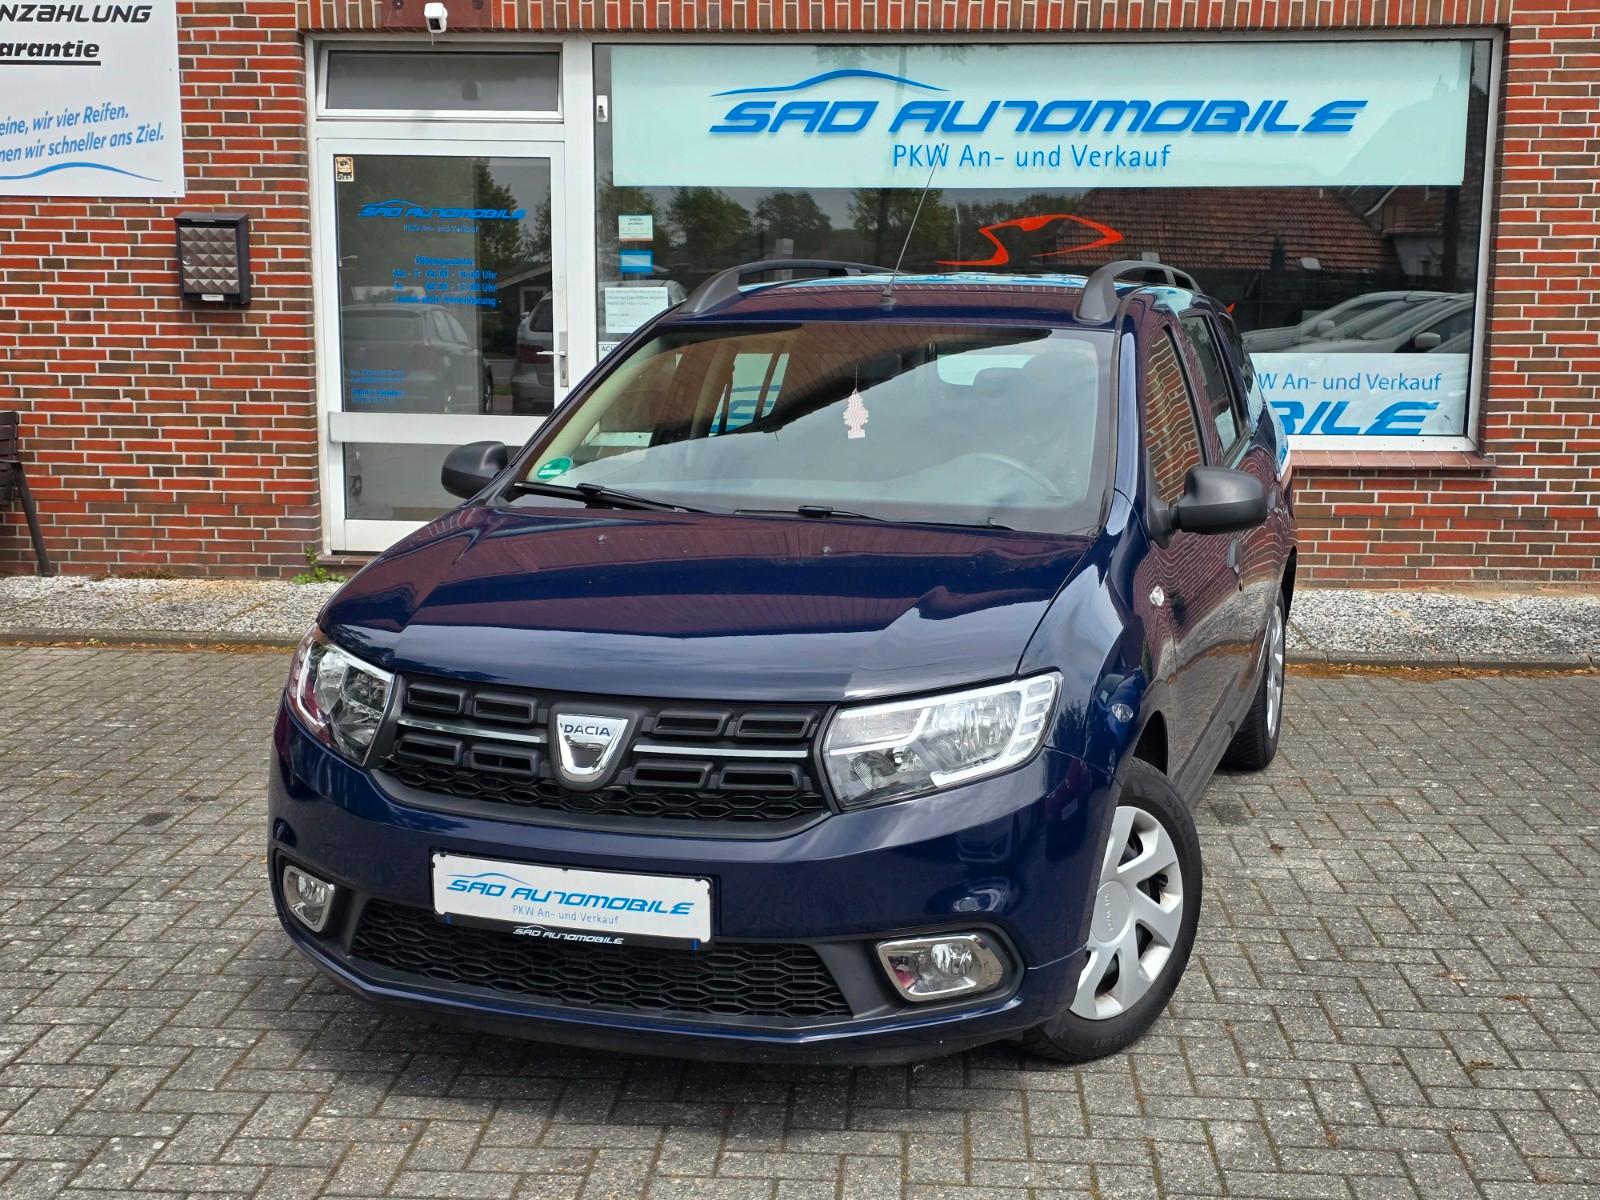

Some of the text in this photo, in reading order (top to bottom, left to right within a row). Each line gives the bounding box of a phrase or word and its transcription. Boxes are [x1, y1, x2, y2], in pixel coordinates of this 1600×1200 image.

[0, 40, 100, 58] arantie
[0, 102, 128, 136] eine, wir vier Reifen.
[709, 100, 1368, 132] SAD AUTOMOBILE
[25, 138, 46, 159] wir
[48, 132, 107, 156] schneller
[109, 132, 133, 148] ans
[136, 122, 164, 144] Ziel.
[892, 144, 1172, 168] PKW An- und Verkauf
[404, 206, 528, 219] AUTOMOBILE
[1283, 373, 1317, 390] An-
[1322, 372, 1361, 391] und
[1366, 372, 1443, 391] Verkauf
[563, 724, 611, 737] DACIA
[446, 879, 695, 916] SAD AUTOMOBILE
[512, 904, 622, 925] PKW An- und Verkauf
[512, 928, 625, 945] SAD AUTOMOBILE
